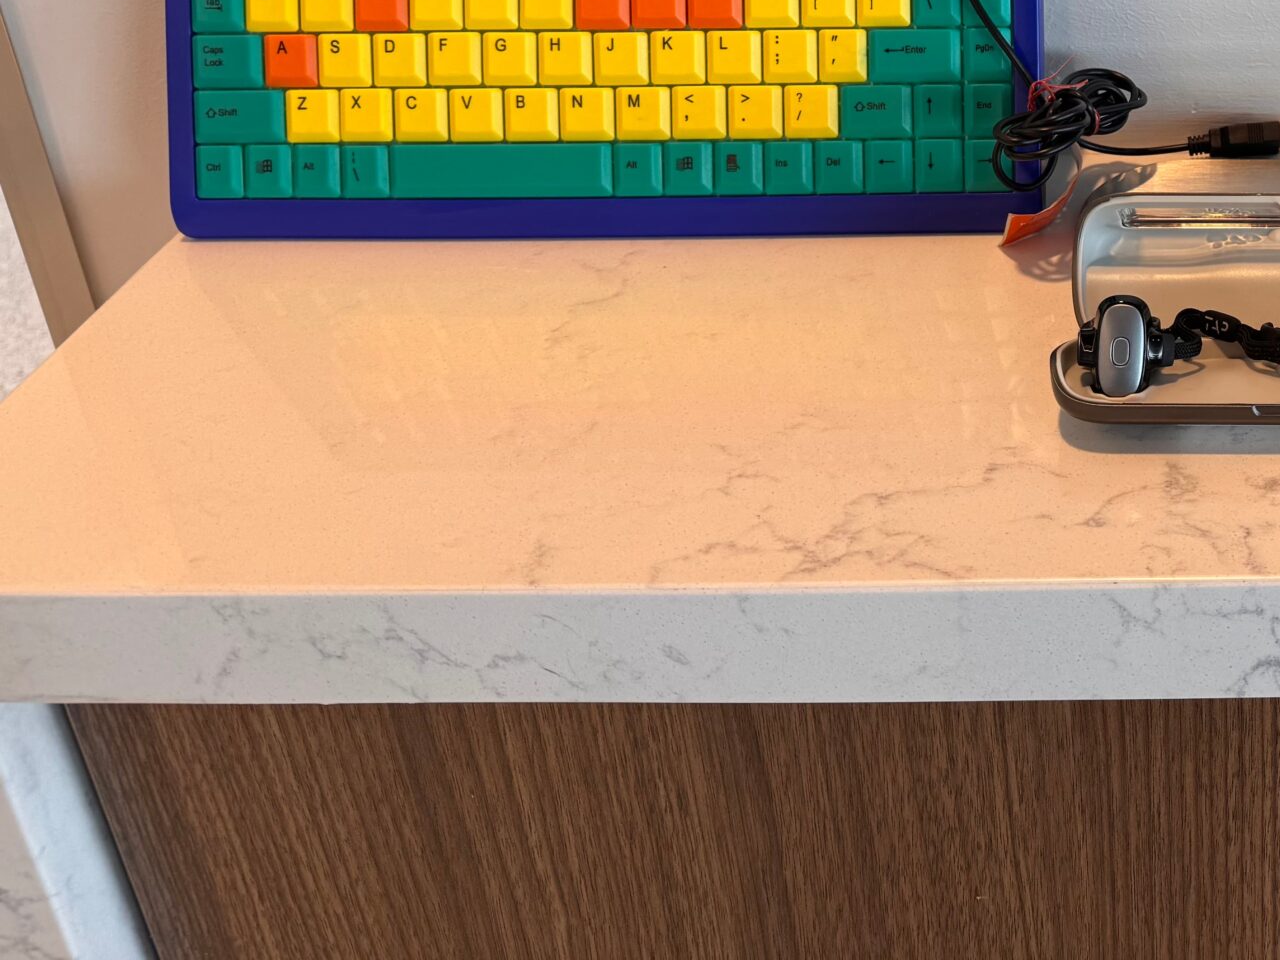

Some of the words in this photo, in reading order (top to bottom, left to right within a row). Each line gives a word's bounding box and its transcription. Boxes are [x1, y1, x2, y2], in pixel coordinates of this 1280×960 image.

[277, 41, 287, 54] A
[331, 40, 340, 53] S
[385, 40, 395, 53] D
[440, 38, 447, 51] F
[495, 38, 506, 52] G
[550, 38, 560, 51] H
[607, 38, 614, 51] J
[663, 37, 672, 50] K
[720, 37, 727, 49] L
[905, 45, 926, 53] Enter
[976, 44, 994, 53] PgDn
[203, 46, 223, 55] Caps
[298, 97, 307, 110] Z
[352, 96, 361, 108] X
[406, 96, 416, 109] C
[461, 96, 472, 109] V
[516, 95, 525, 108] B
[572, 95, 582, 108] N
[628, 94, 640, 107] M
[867, 102, 885, 110] Shift
[977, 101, 991, 109] End
[827, 157, 840, 166] Del
